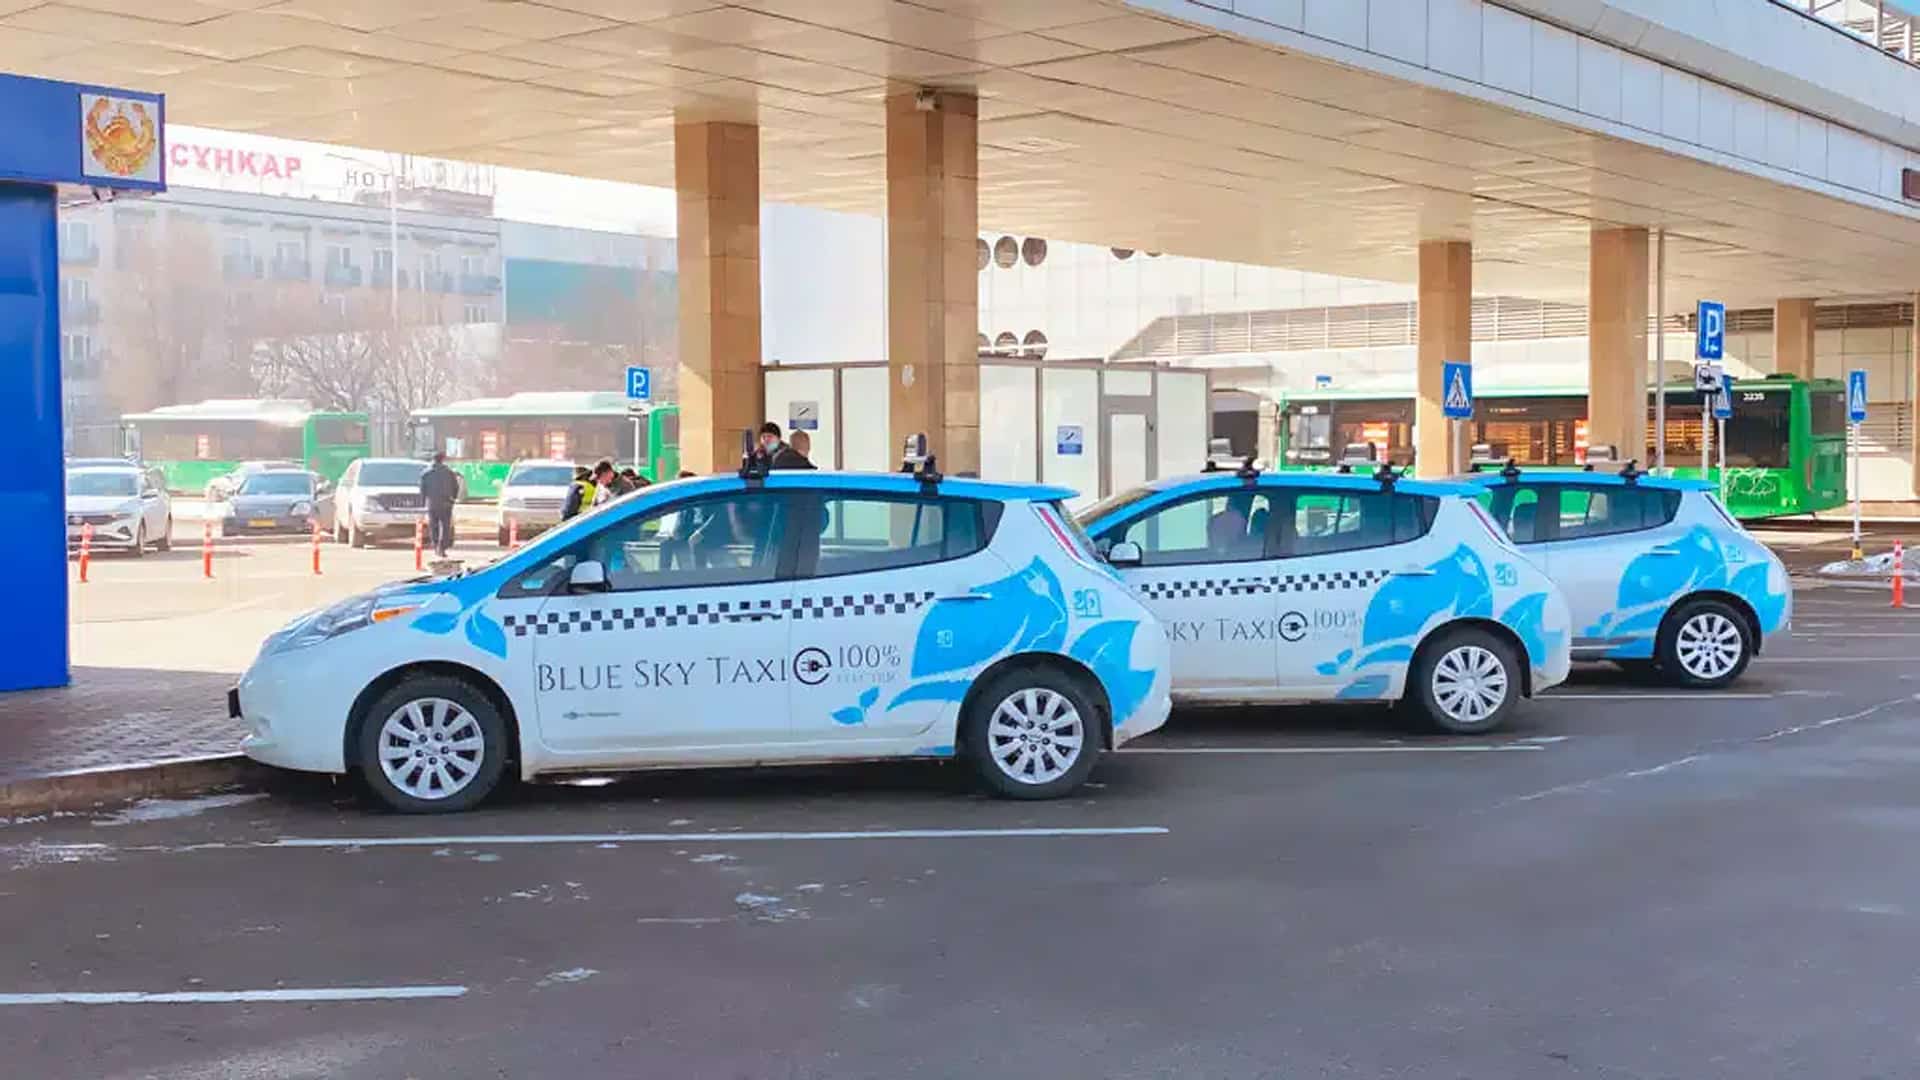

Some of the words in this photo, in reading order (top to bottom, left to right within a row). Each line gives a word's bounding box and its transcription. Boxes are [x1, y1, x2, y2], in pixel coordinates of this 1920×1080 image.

[1164, 621, 1206, 642] KY
[1214, 618, 1274, 642] TAXI
[839, 644, 901, 668] 100%
[537, 663, 623, 693] BLUE
[633, 659, 697, 688] SKY
[706, 655, 787, 685] TAXI
